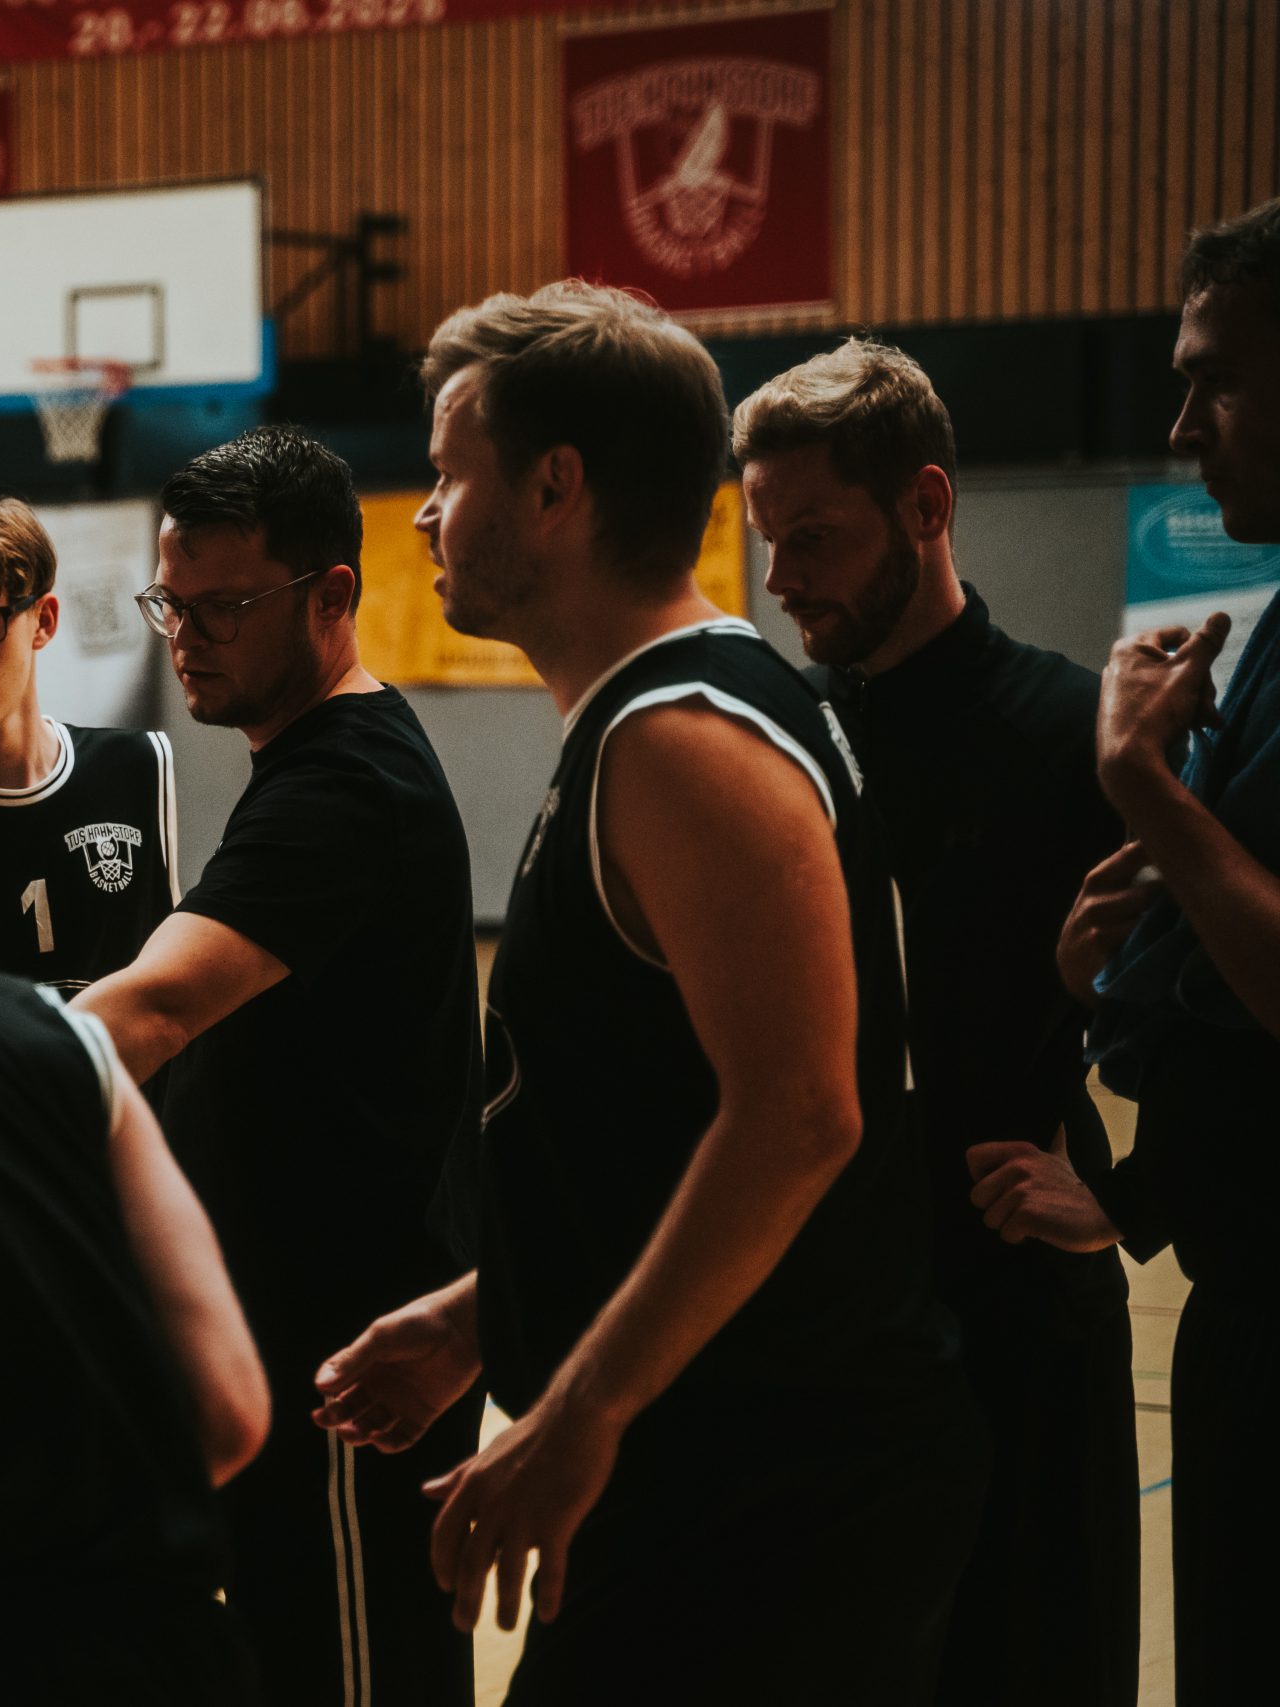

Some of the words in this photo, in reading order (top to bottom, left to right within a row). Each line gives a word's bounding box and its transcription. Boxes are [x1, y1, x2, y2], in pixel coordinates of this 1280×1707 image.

[65, 828, 86, 851] TUS
[86, 823, 141, 846] HOHNSTORF
[89, 866, 133, 893] BASKETBALL
[21, 878, 55, 954] 1
